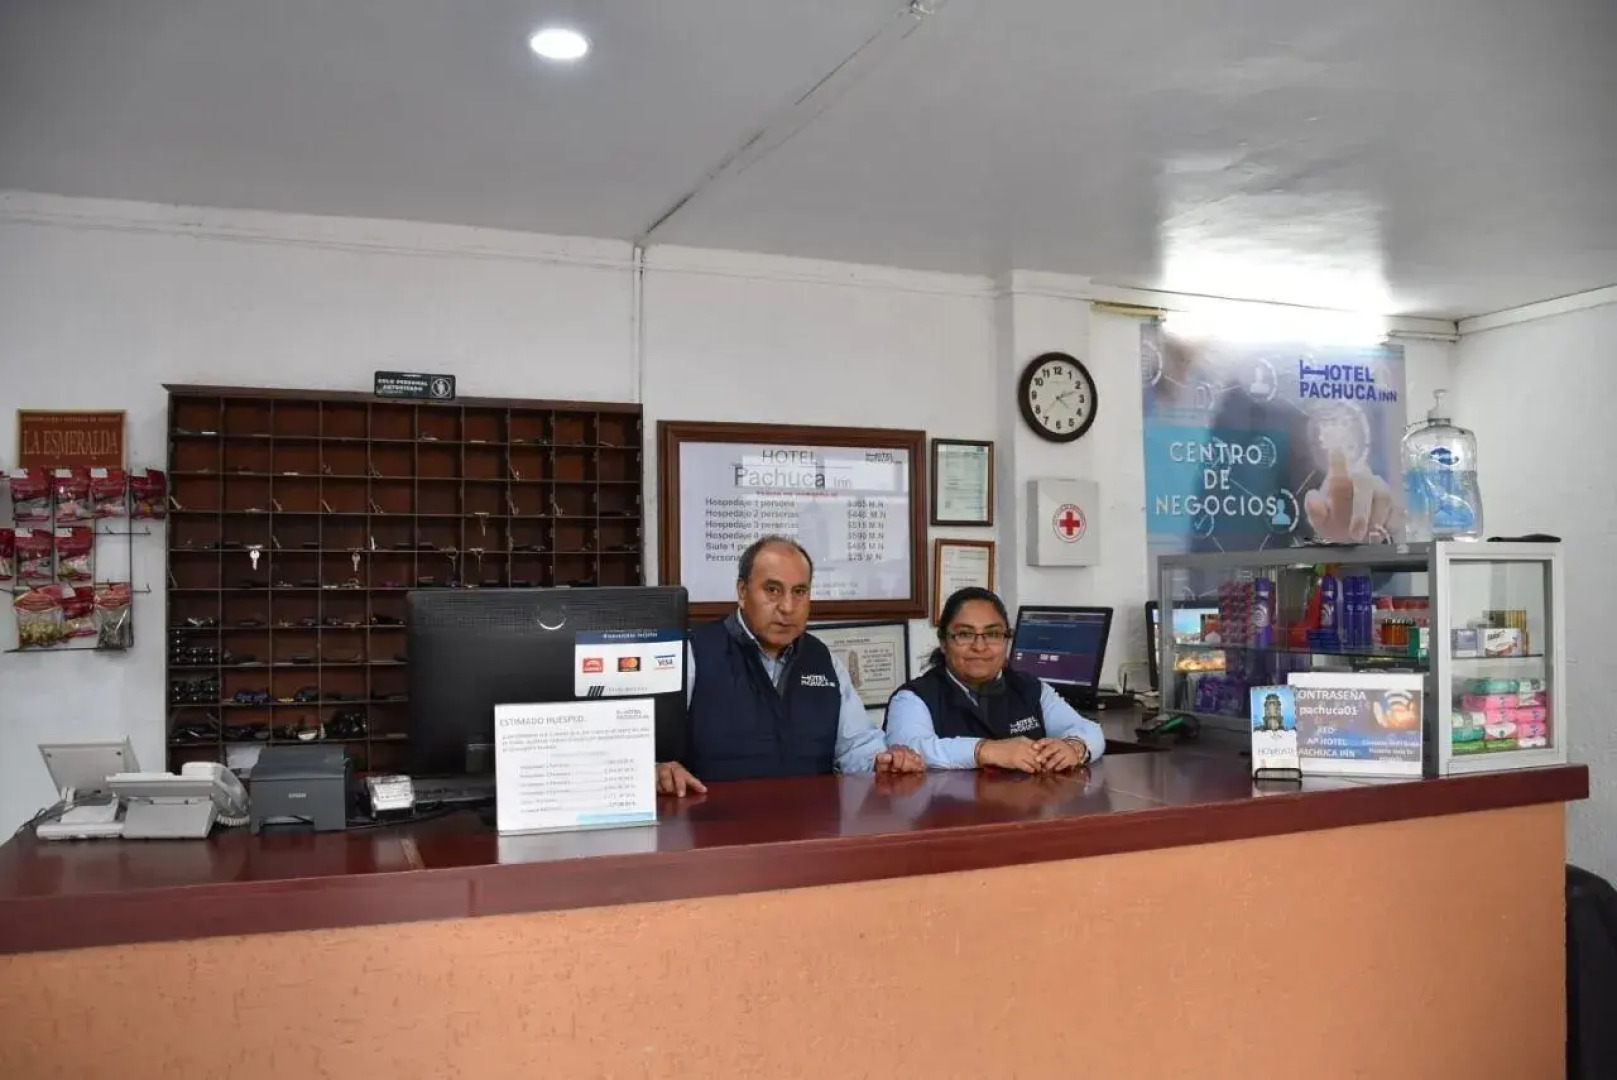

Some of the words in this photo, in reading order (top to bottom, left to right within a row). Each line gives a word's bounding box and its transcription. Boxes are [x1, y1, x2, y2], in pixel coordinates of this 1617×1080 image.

[1042, 369, 1050, 378] 11
[1053, 366, 1062, 376] 12
[1067, 370, 1072, 380] 1
[1299, 359, 1375, 383] HOTEL
[1034, 378, 1044, 387] 10
[1075, 381, 1081, 390] 2
[1031, 391, 1037, 400] 9
[1299, 382, 1377, 400] PACHUCA
[1379, 389, 1397, 402] INN
[1078, 394, 1085, 403] 3
[1035, 404, 1041, 414] 8
[1076, 408, 1082, 417] 4
[1043, 416, 1049, 425] 7
[1056, 420, 1062, 430] 6
[1069, 418, 1075, 427] 5
[24, 430, 40, 455] LA
[43, 430, 119, 456] ESMERALDA
[762, 450, 818, 465] HOTEL
[1169, 441, 1262, 465] CENTRO
[734, 464, 826, 489] Pachuca
[1204, 469, 1231, 490] DE
[706, 498, 752, 507] Hospedaje
[1156, 495, 1277, 516] NEGOCIOS
[706, 510, 752, 518] Hospedaje
[706, 521, 752, 530] Hospedaje
[706, 532, 752, 541] Hospedaje
[1299, 705, 1358, 717] pachuca01
[499, 717, 544, 728] ESTIMADO
